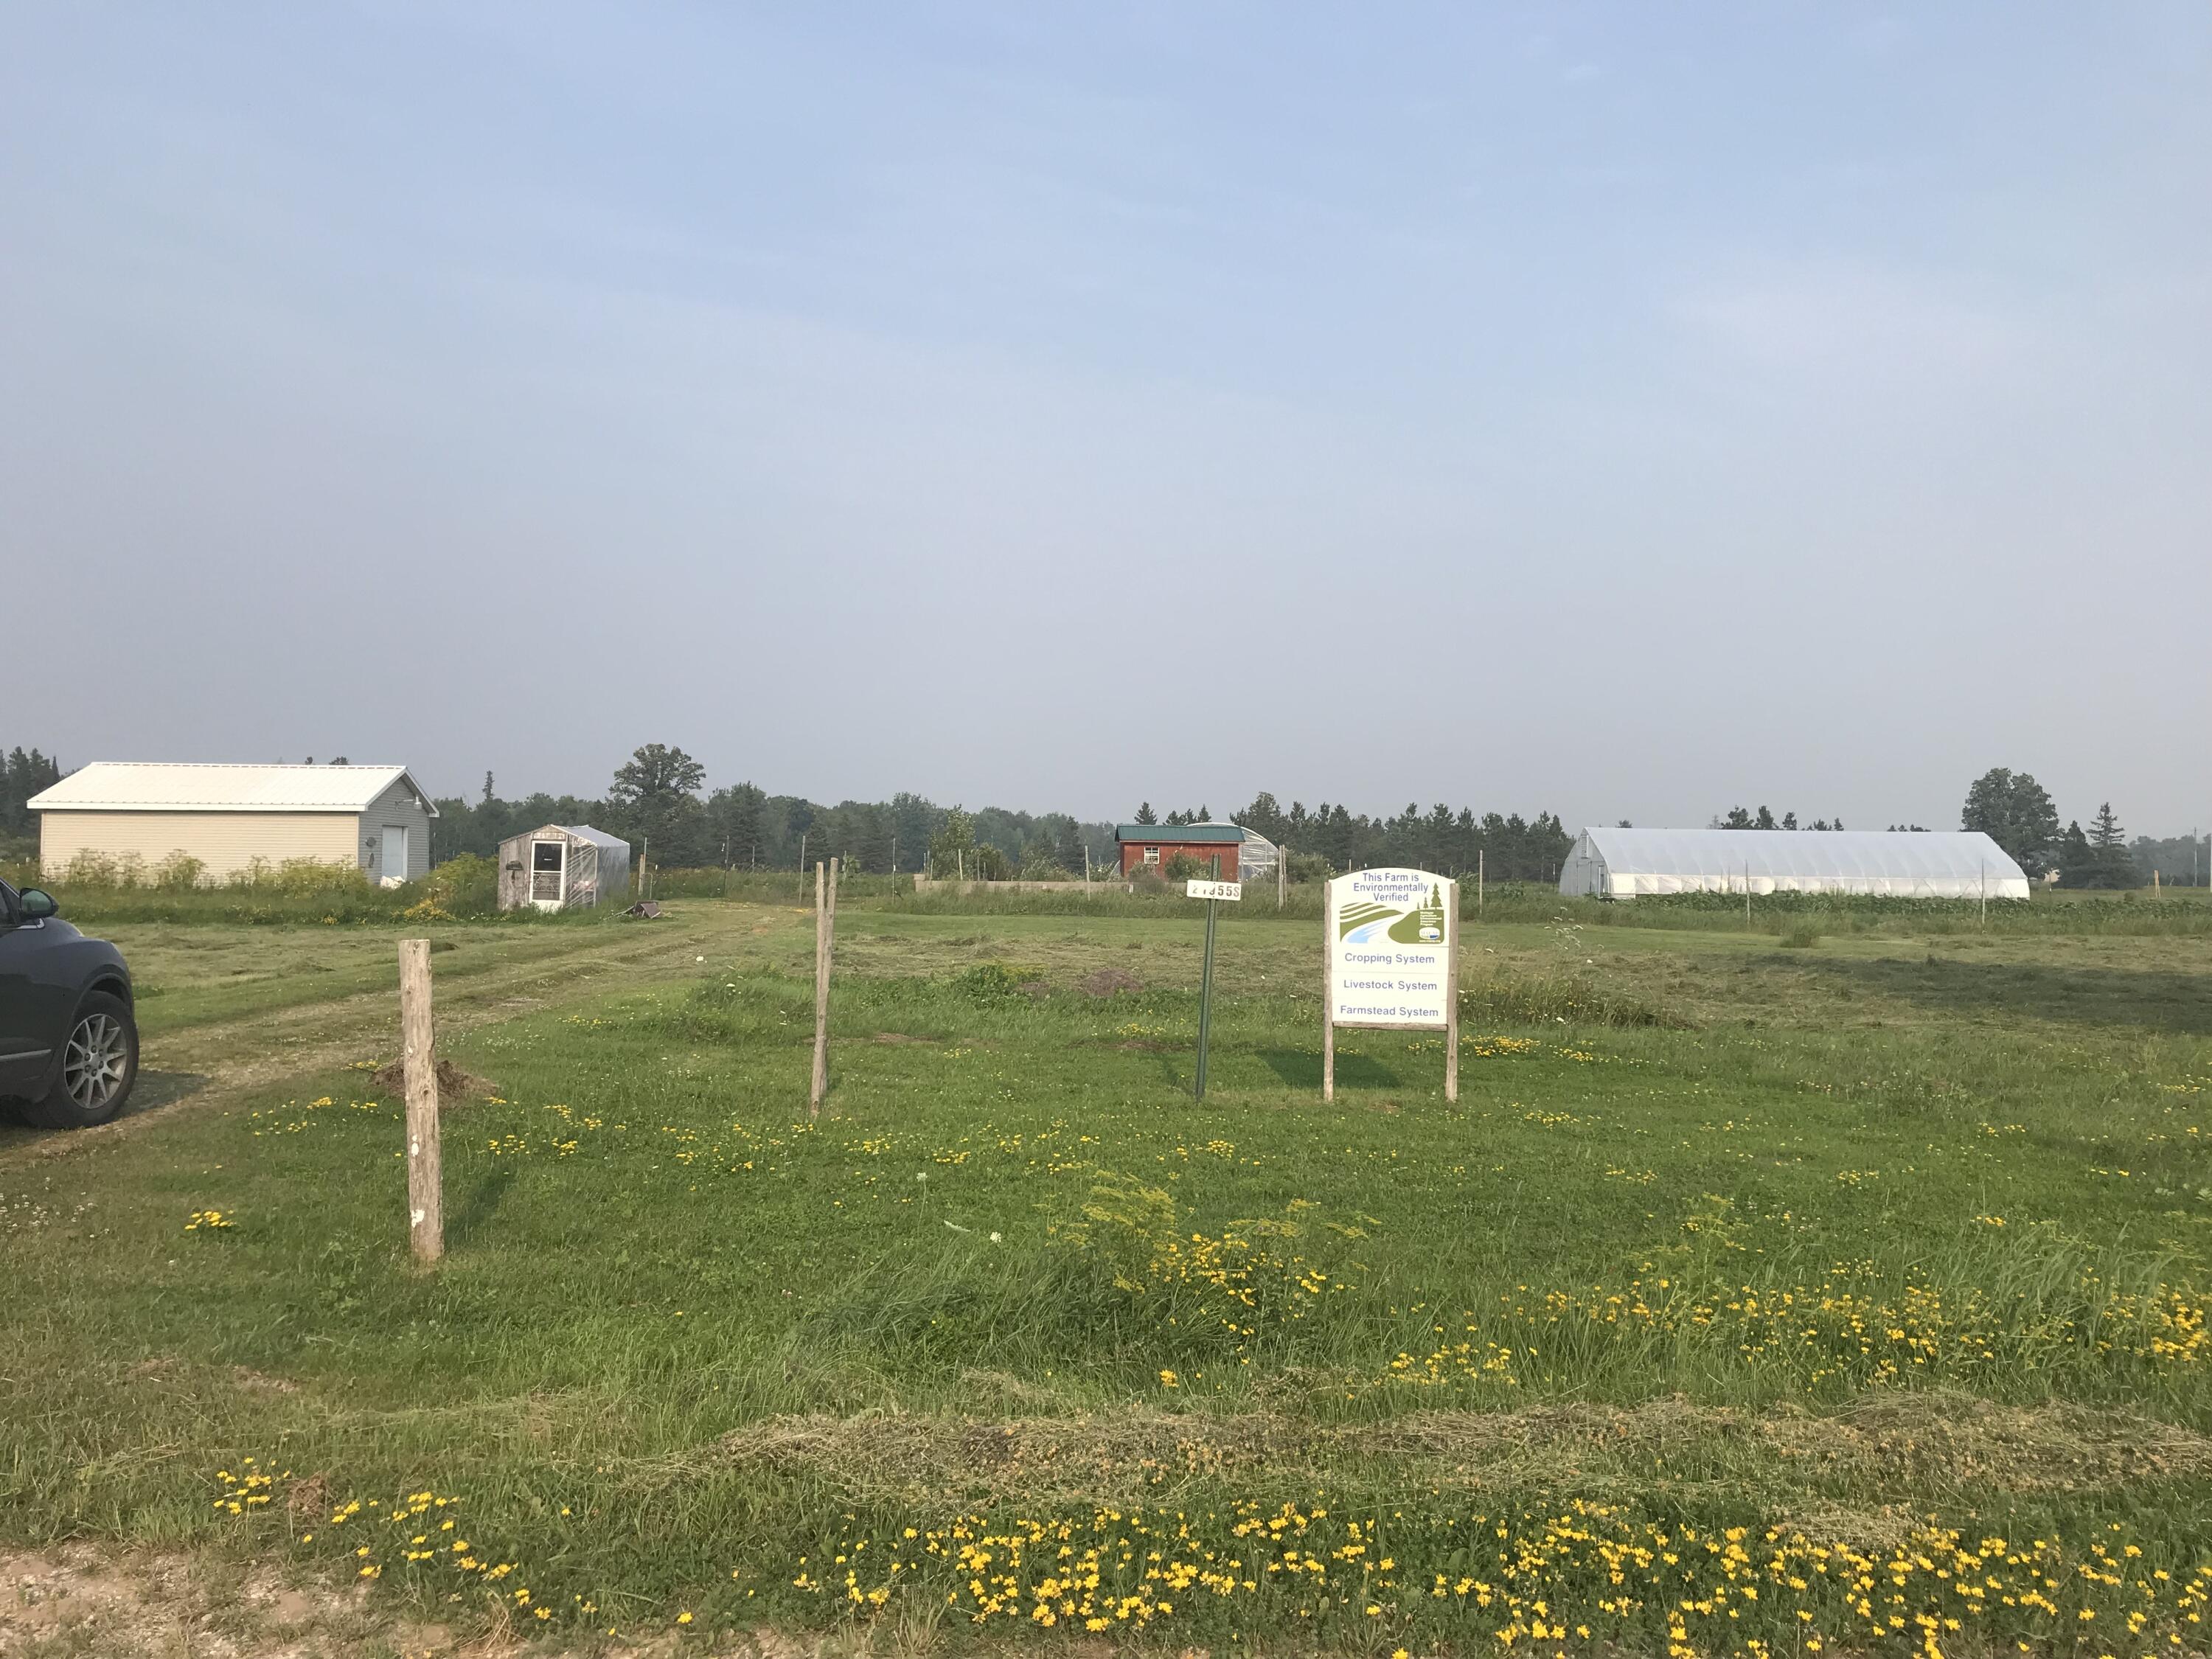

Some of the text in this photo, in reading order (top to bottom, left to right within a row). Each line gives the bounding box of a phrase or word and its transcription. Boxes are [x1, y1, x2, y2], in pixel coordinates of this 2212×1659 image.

[1363, 872, 1419, 882] This Farm is
[1354, 883, 1429, 894] Environmentally
[1373, 893, 1409, 902] Verified
[1344, 953, 1435, 965] Cropping System
[1343, 979, 1437, 992] Livestock System
[1340, 1005, 1439, 1018] Farmstead System
